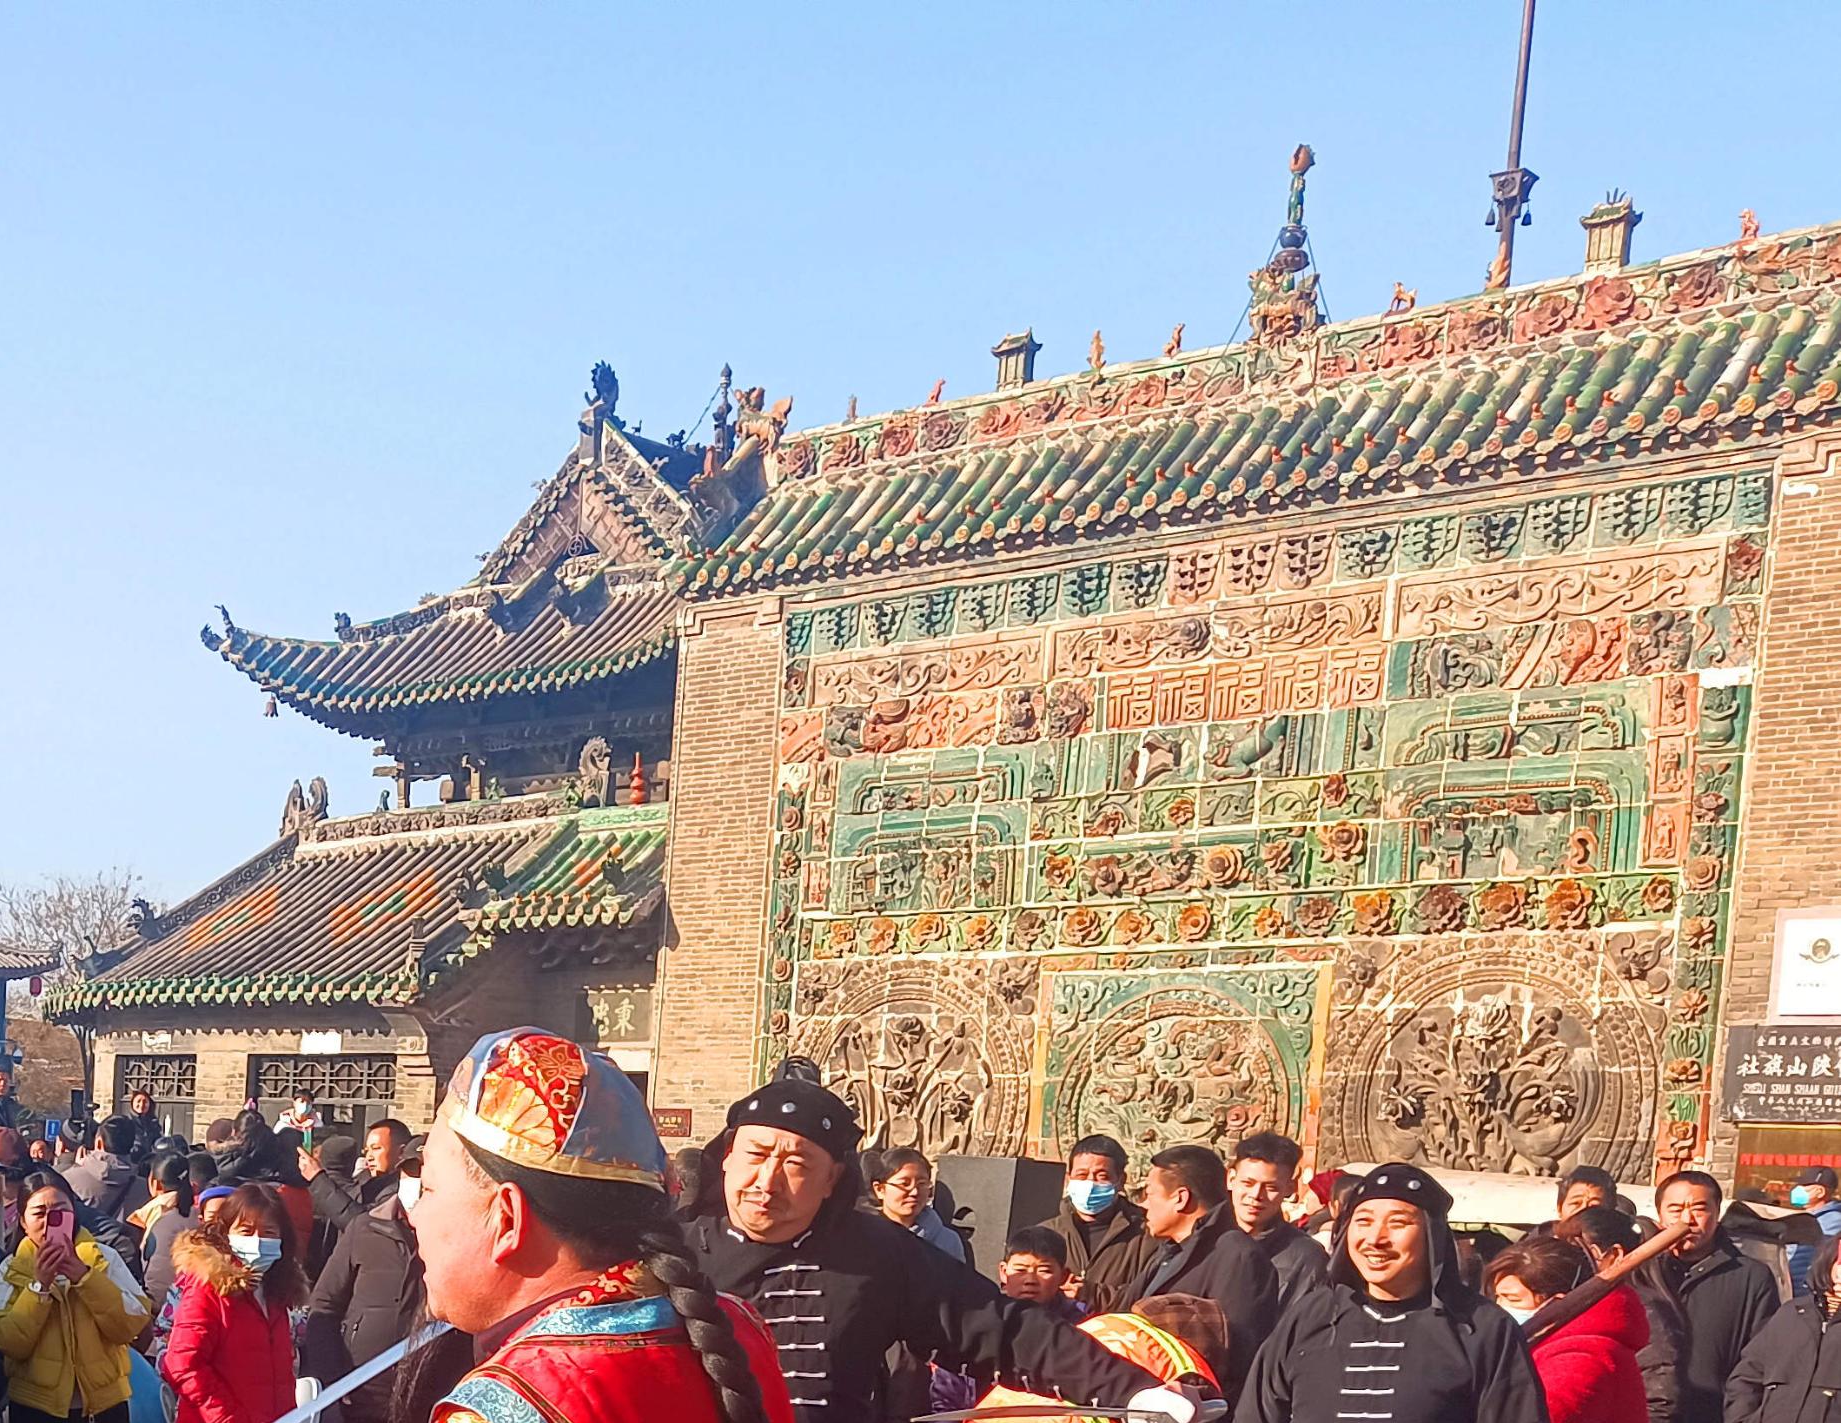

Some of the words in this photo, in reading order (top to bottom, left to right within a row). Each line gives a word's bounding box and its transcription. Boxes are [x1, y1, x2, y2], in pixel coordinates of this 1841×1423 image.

[1109, 650, 1382, 728] 福福福福福
